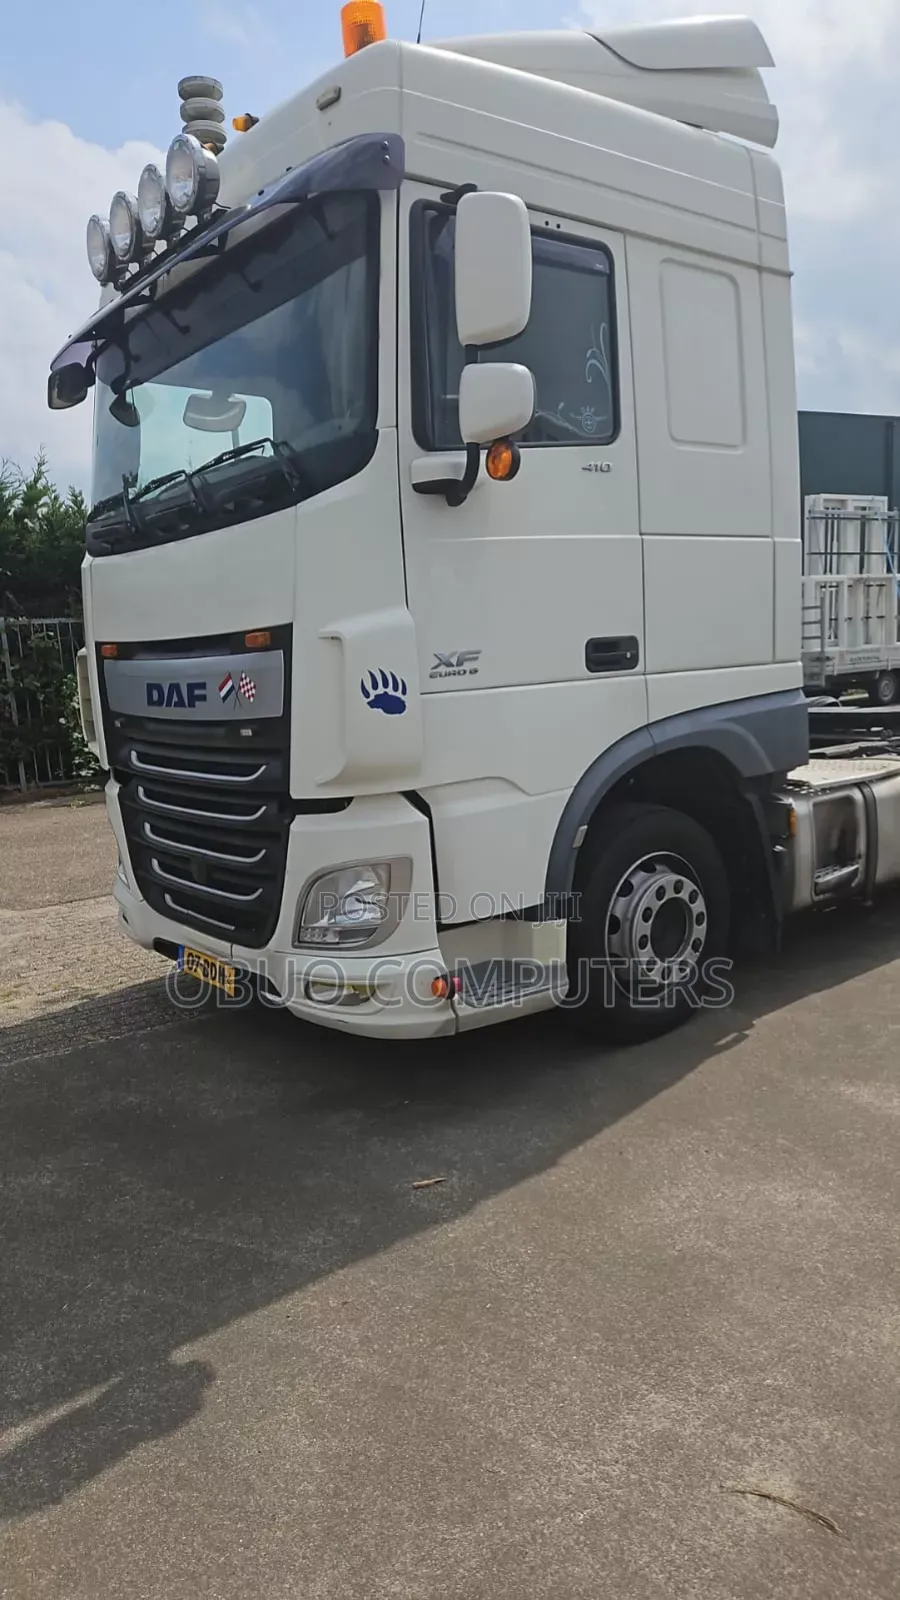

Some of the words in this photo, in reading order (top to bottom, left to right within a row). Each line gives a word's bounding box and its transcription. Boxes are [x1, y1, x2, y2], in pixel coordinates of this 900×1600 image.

[581, 461, 612, 473] 410
[430, 649, 483, 670] XF
[429, 668, 467, 679] EURO
[469, 667, 479, 675] 6
[146, 682, 207, 708] DAF
